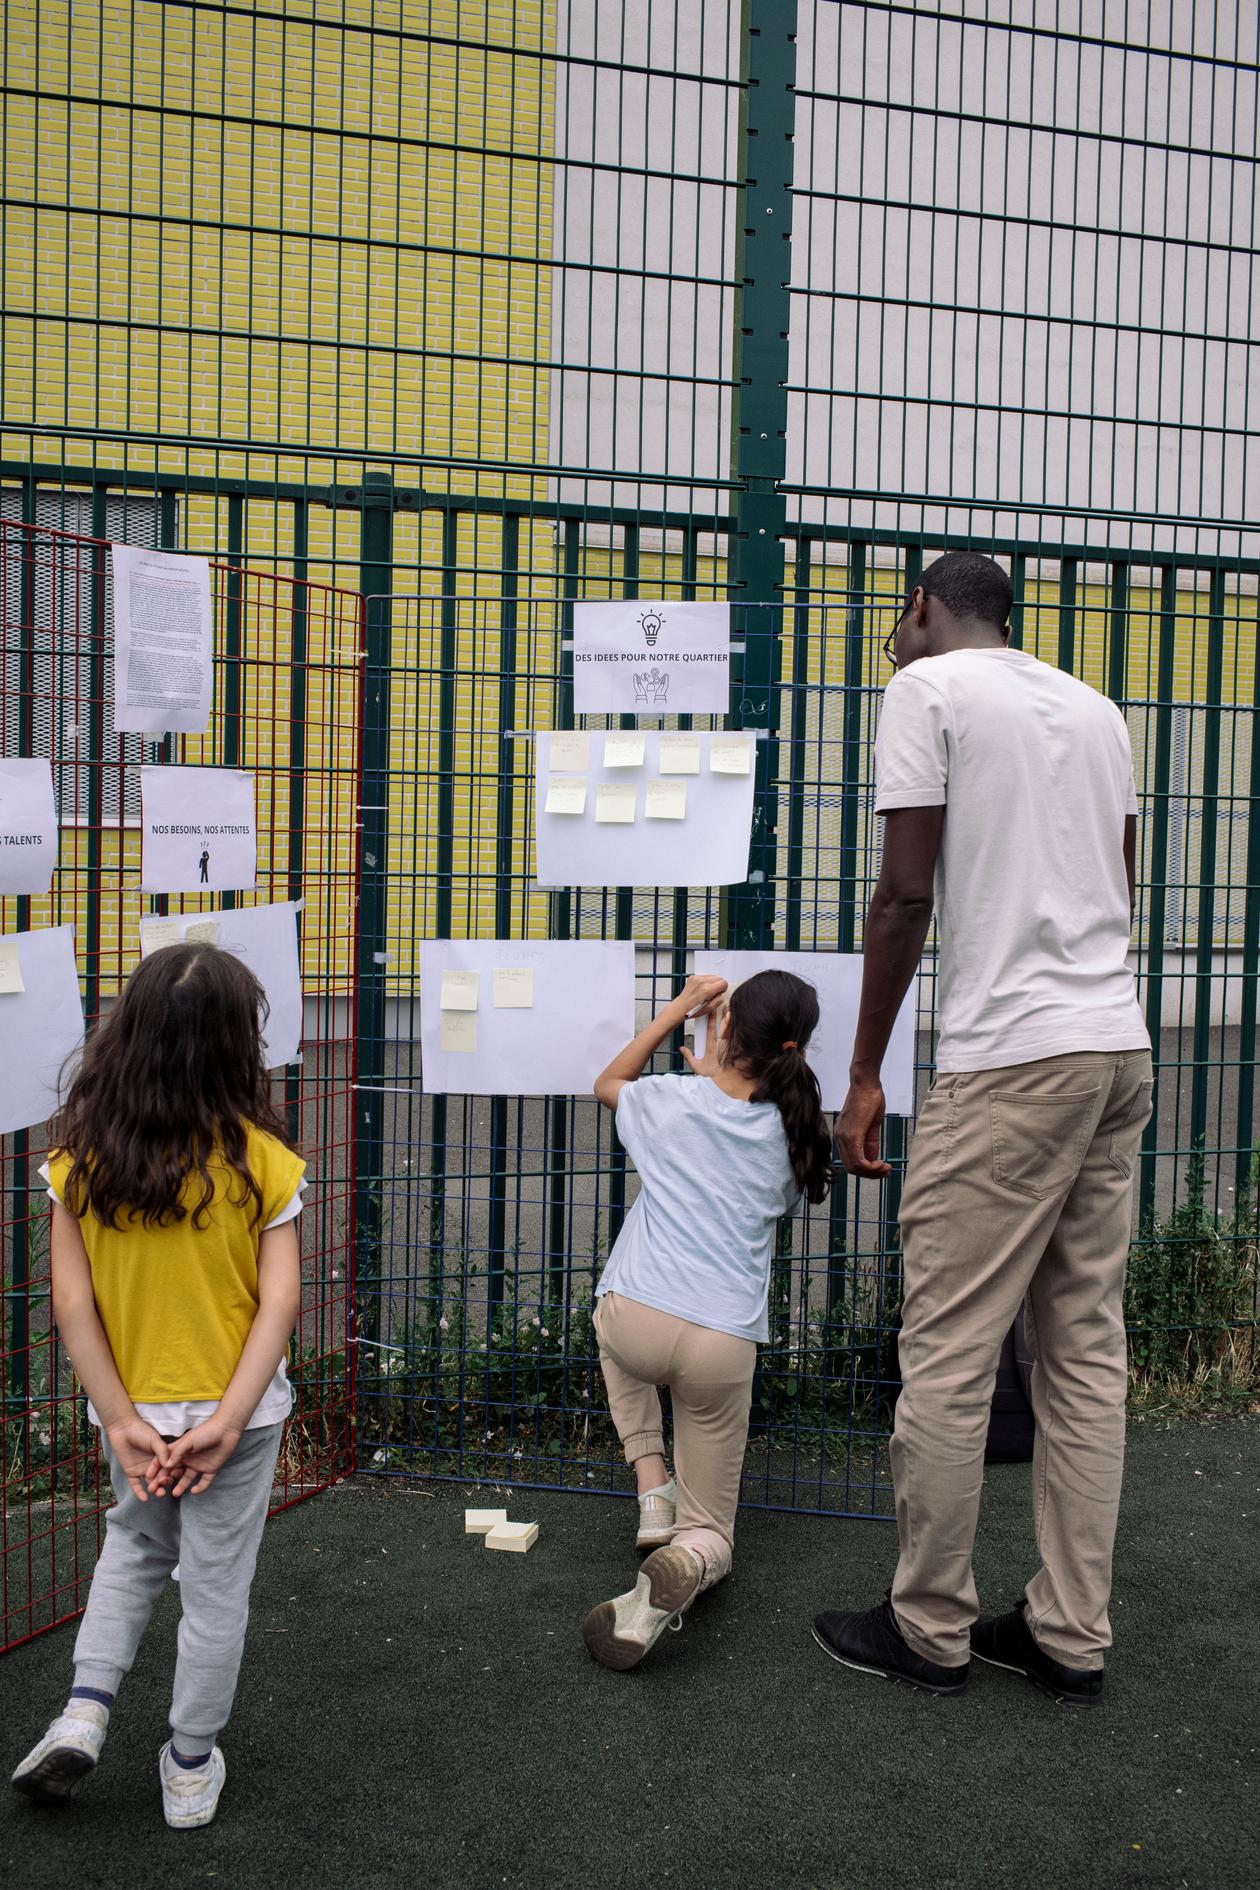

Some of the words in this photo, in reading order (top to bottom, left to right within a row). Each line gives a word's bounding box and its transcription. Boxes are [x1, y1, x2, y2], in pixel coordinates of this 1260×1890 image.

[575, 653, 592, 662] DES
[594, 653, 619, 662] IDEES
[621, 653, 647, 662] POUR
[649, 653, 680, 662] NOTRE
[682, 653, 728, 663] QUARTIER
[152, 825, 169, 834] NOS
[170, 825, 203, 836] BESOINS,
[204, 825, 219, 834] NOS
[219, 825, 250, 835] ATTENTES
[3, 835, 42, 845] TALENTS
